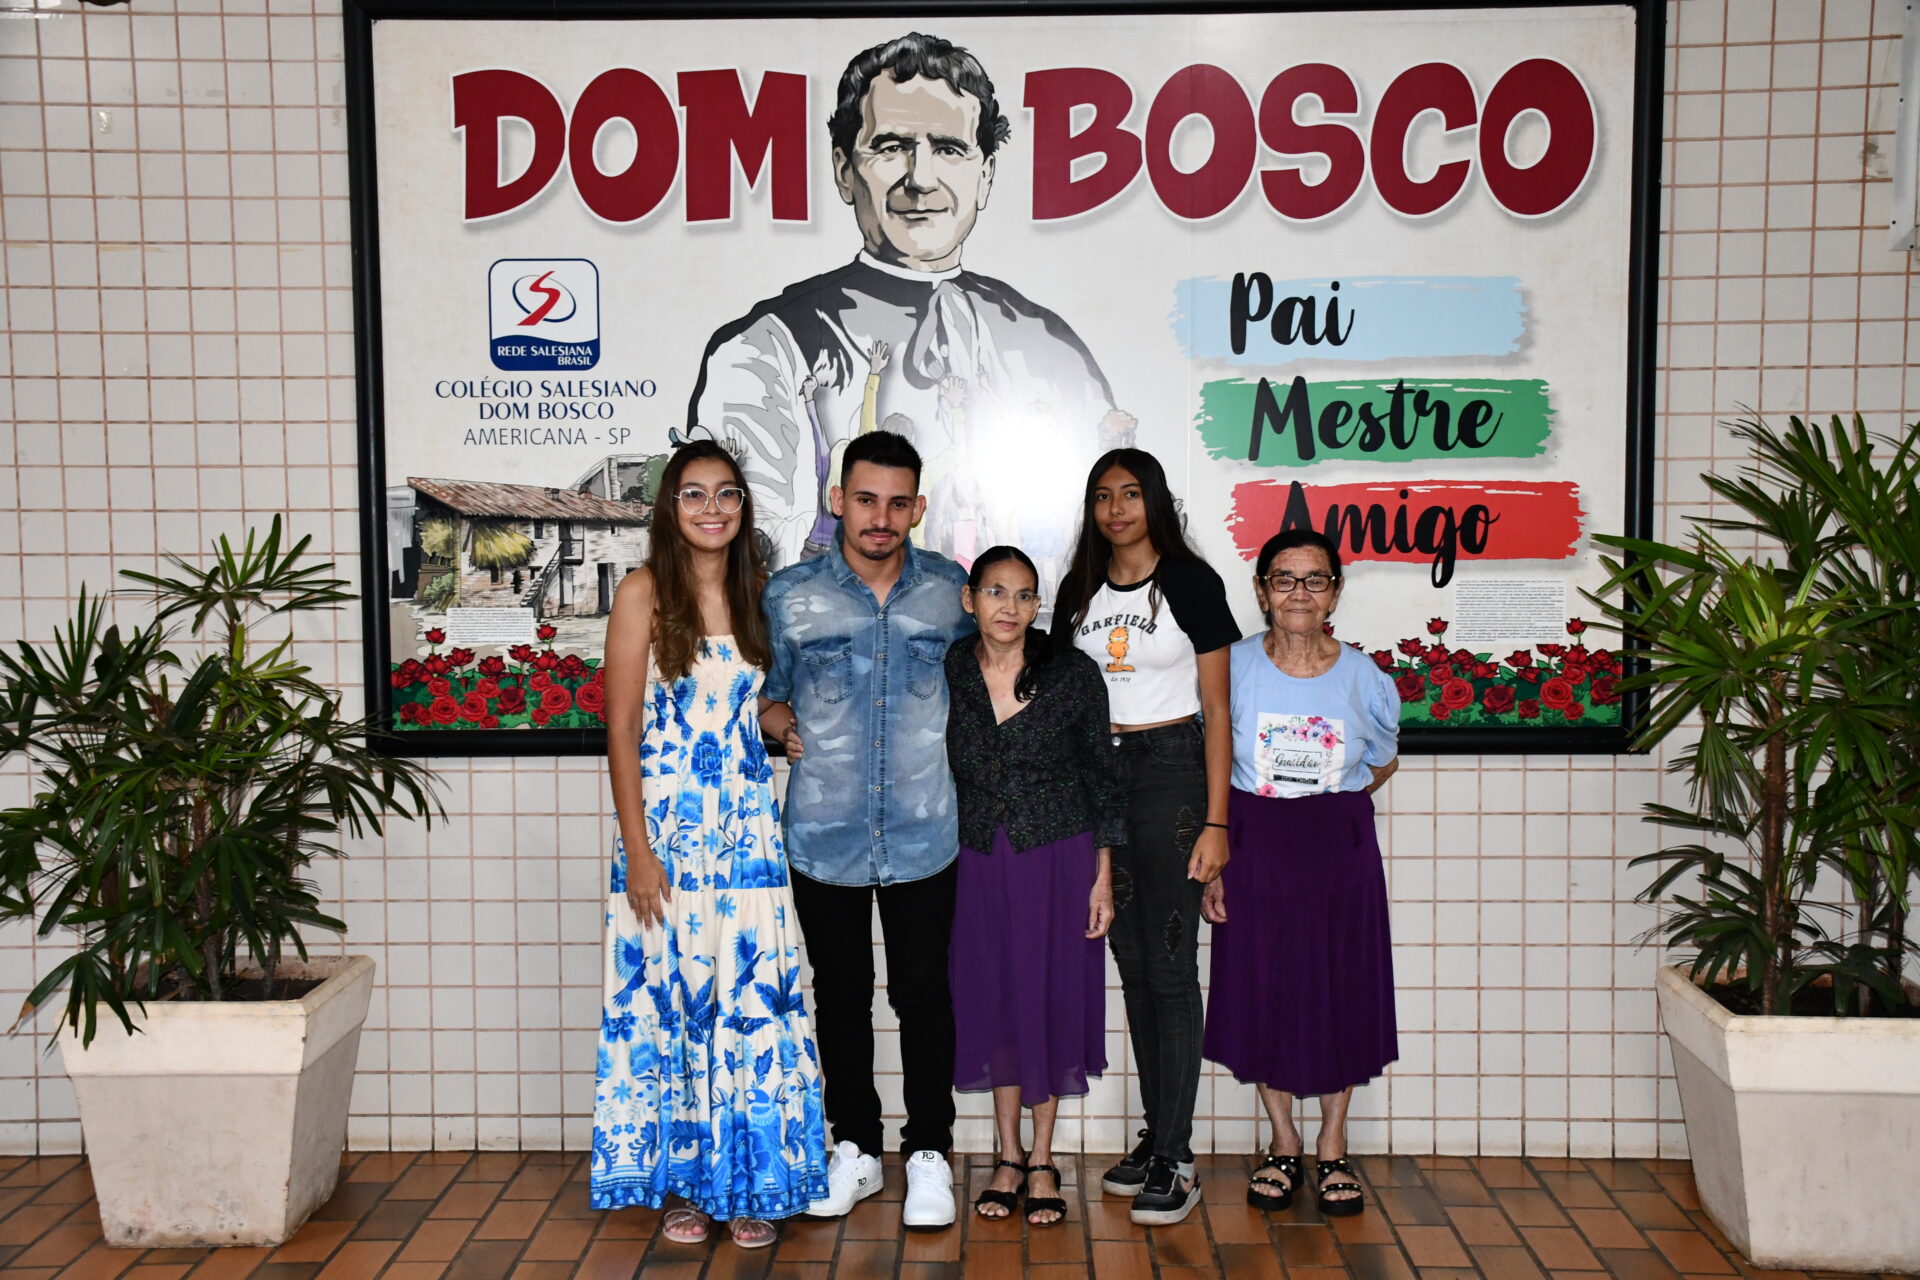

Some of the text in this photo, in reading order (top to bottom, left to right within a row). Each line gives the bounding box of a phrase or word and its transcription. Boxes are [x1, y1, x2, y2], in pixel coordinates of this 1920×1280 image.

[453, 58, 1595, 222] DOM BOSCO
[1230, 272, 1355, 354] Pai
[497, 346, 593, 357] REDE SALESIANA
[557, 356, 592, 366] BRASIL
[435, 376, 657, 398] COLÉGIO SALESIANO
[479, 401, 614, 420] DOM BOSCO
[1248, 375, 1503, 461] Mestre
[463, 428, 588, 446] AMERICANA
[608, 427, 631, 445] SP
[1279, 480, 1500, 588] Amigo
[1081, 613, 1158, 636] GARFIELD
